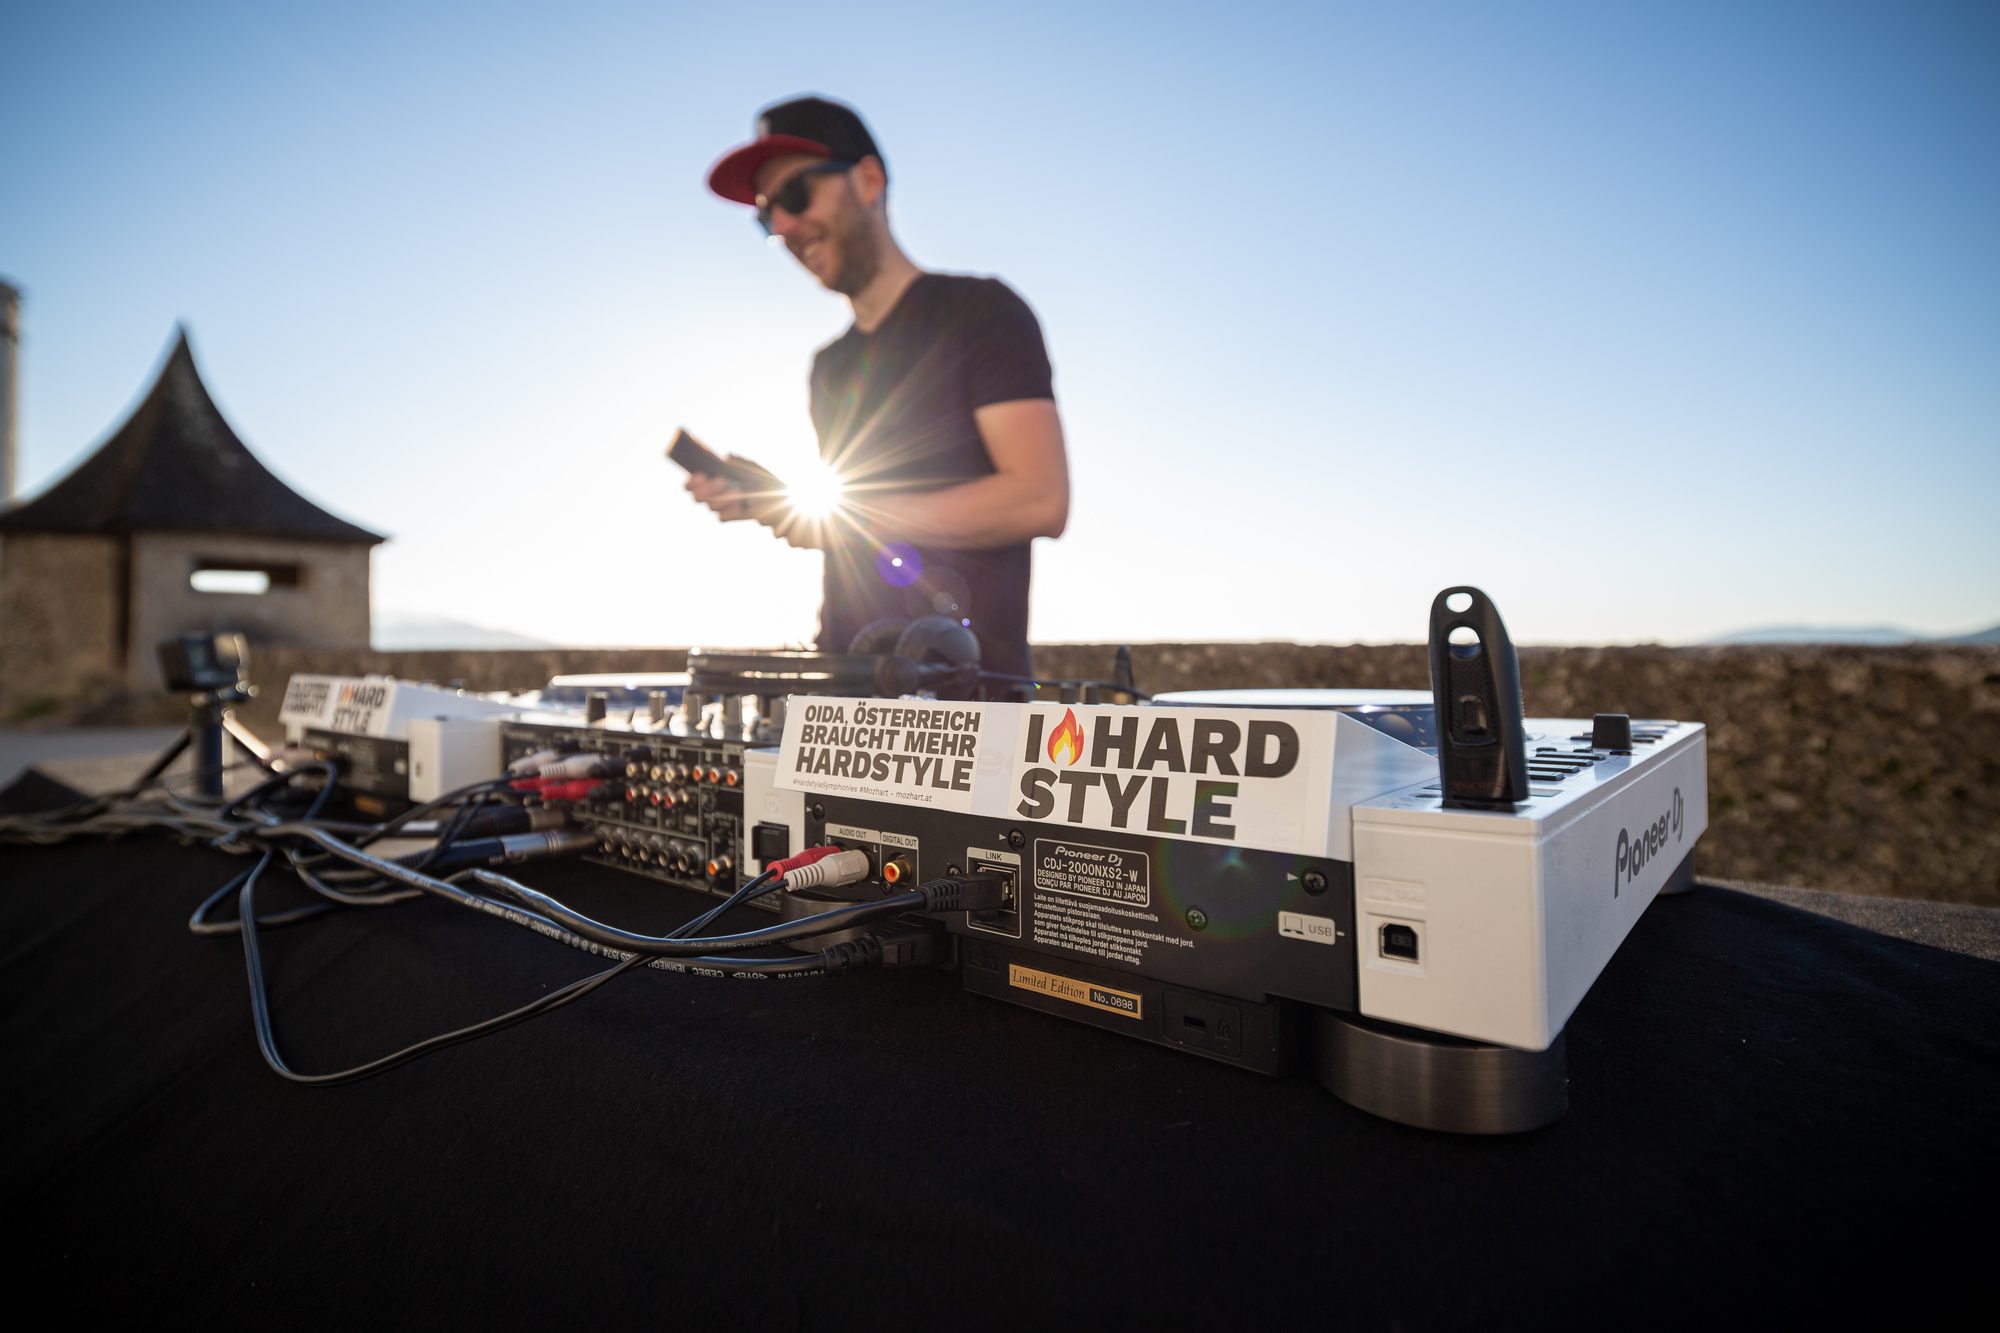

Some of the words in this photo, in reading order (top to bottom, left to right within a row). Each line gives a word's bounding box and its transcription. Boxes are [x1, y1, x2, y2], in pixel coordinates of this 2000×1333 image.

[804, 704, 848, 726] OIDA,
[853, 701, 981, 733] ÖSTERREICH
[800, 724, 900, 751] BRAUCHT
[903, 730, 977, 758] MEHR
[1024, 714, 1045, 763] I
[1090, 715, 1300, 779] HARD
[795, 746, 974, 792] HARDSTYLE
[792, 778, 858, 793] #HardstyleSymphonies
[859, 786, 888, 797] #Mozhart
[895, 791, 932, 802] mozhart.at
[1016, 767, 1240, 841] STYLE
[839, 828, 855, 837] AUDIO
[855, 830, 866, 839] OUT
[882, 834, 904, 846] DIGITAL
[904, 838, 917, 848] OUT
[985, 851, 1002, 861] LINK
[1055, 845, 1106, 861] Pioneer
[1614, 810, 1670, 900] Pioneer
[1037, 868, 1067, 881] DESIGNED
[1068, 873, 1077, 882] BY
[1077, 875, 1105, 887] PIONEER
[1106, 880, 1115, 889] DJ
[1116, 881, 1123, 890] IN
[1123, 883, 1146, 894] JAPAN
[1043, 856, 1139, 883] CDJ-2000NXS2-W
[1033, 892, 1047, 902] Laite
[1037, 877, 1059, 888] CONÇU
[1059, 880, 1072, 889] PAR
[1073, 882, 1101, 894] PIONEER
[1102, 887, 1111, 896] DJ
[1112, 889, 1122, 898] AU
[1123, 890, 1146, 902] JAPON
[1046, 921, 1059, 930] giver
[1085, 920, 1097, 929] skal
[1131, 929, 1164, 942] stikkontakt
[1165, 935, 1179, 945] med
[1308, 924, 1333, 937] USB
[1092, 939, 1109, 949] jordet
[1106, 950, 1123, 961] jordat
[692, 967, 725, 978] CEBEC
[1013, 969, 1047, 990] Limited
[1050, 978, 1085, 999] Edition
[1093, 991, 1108, 1004] No.
[1110, 996, 1133, 1010] 0698
